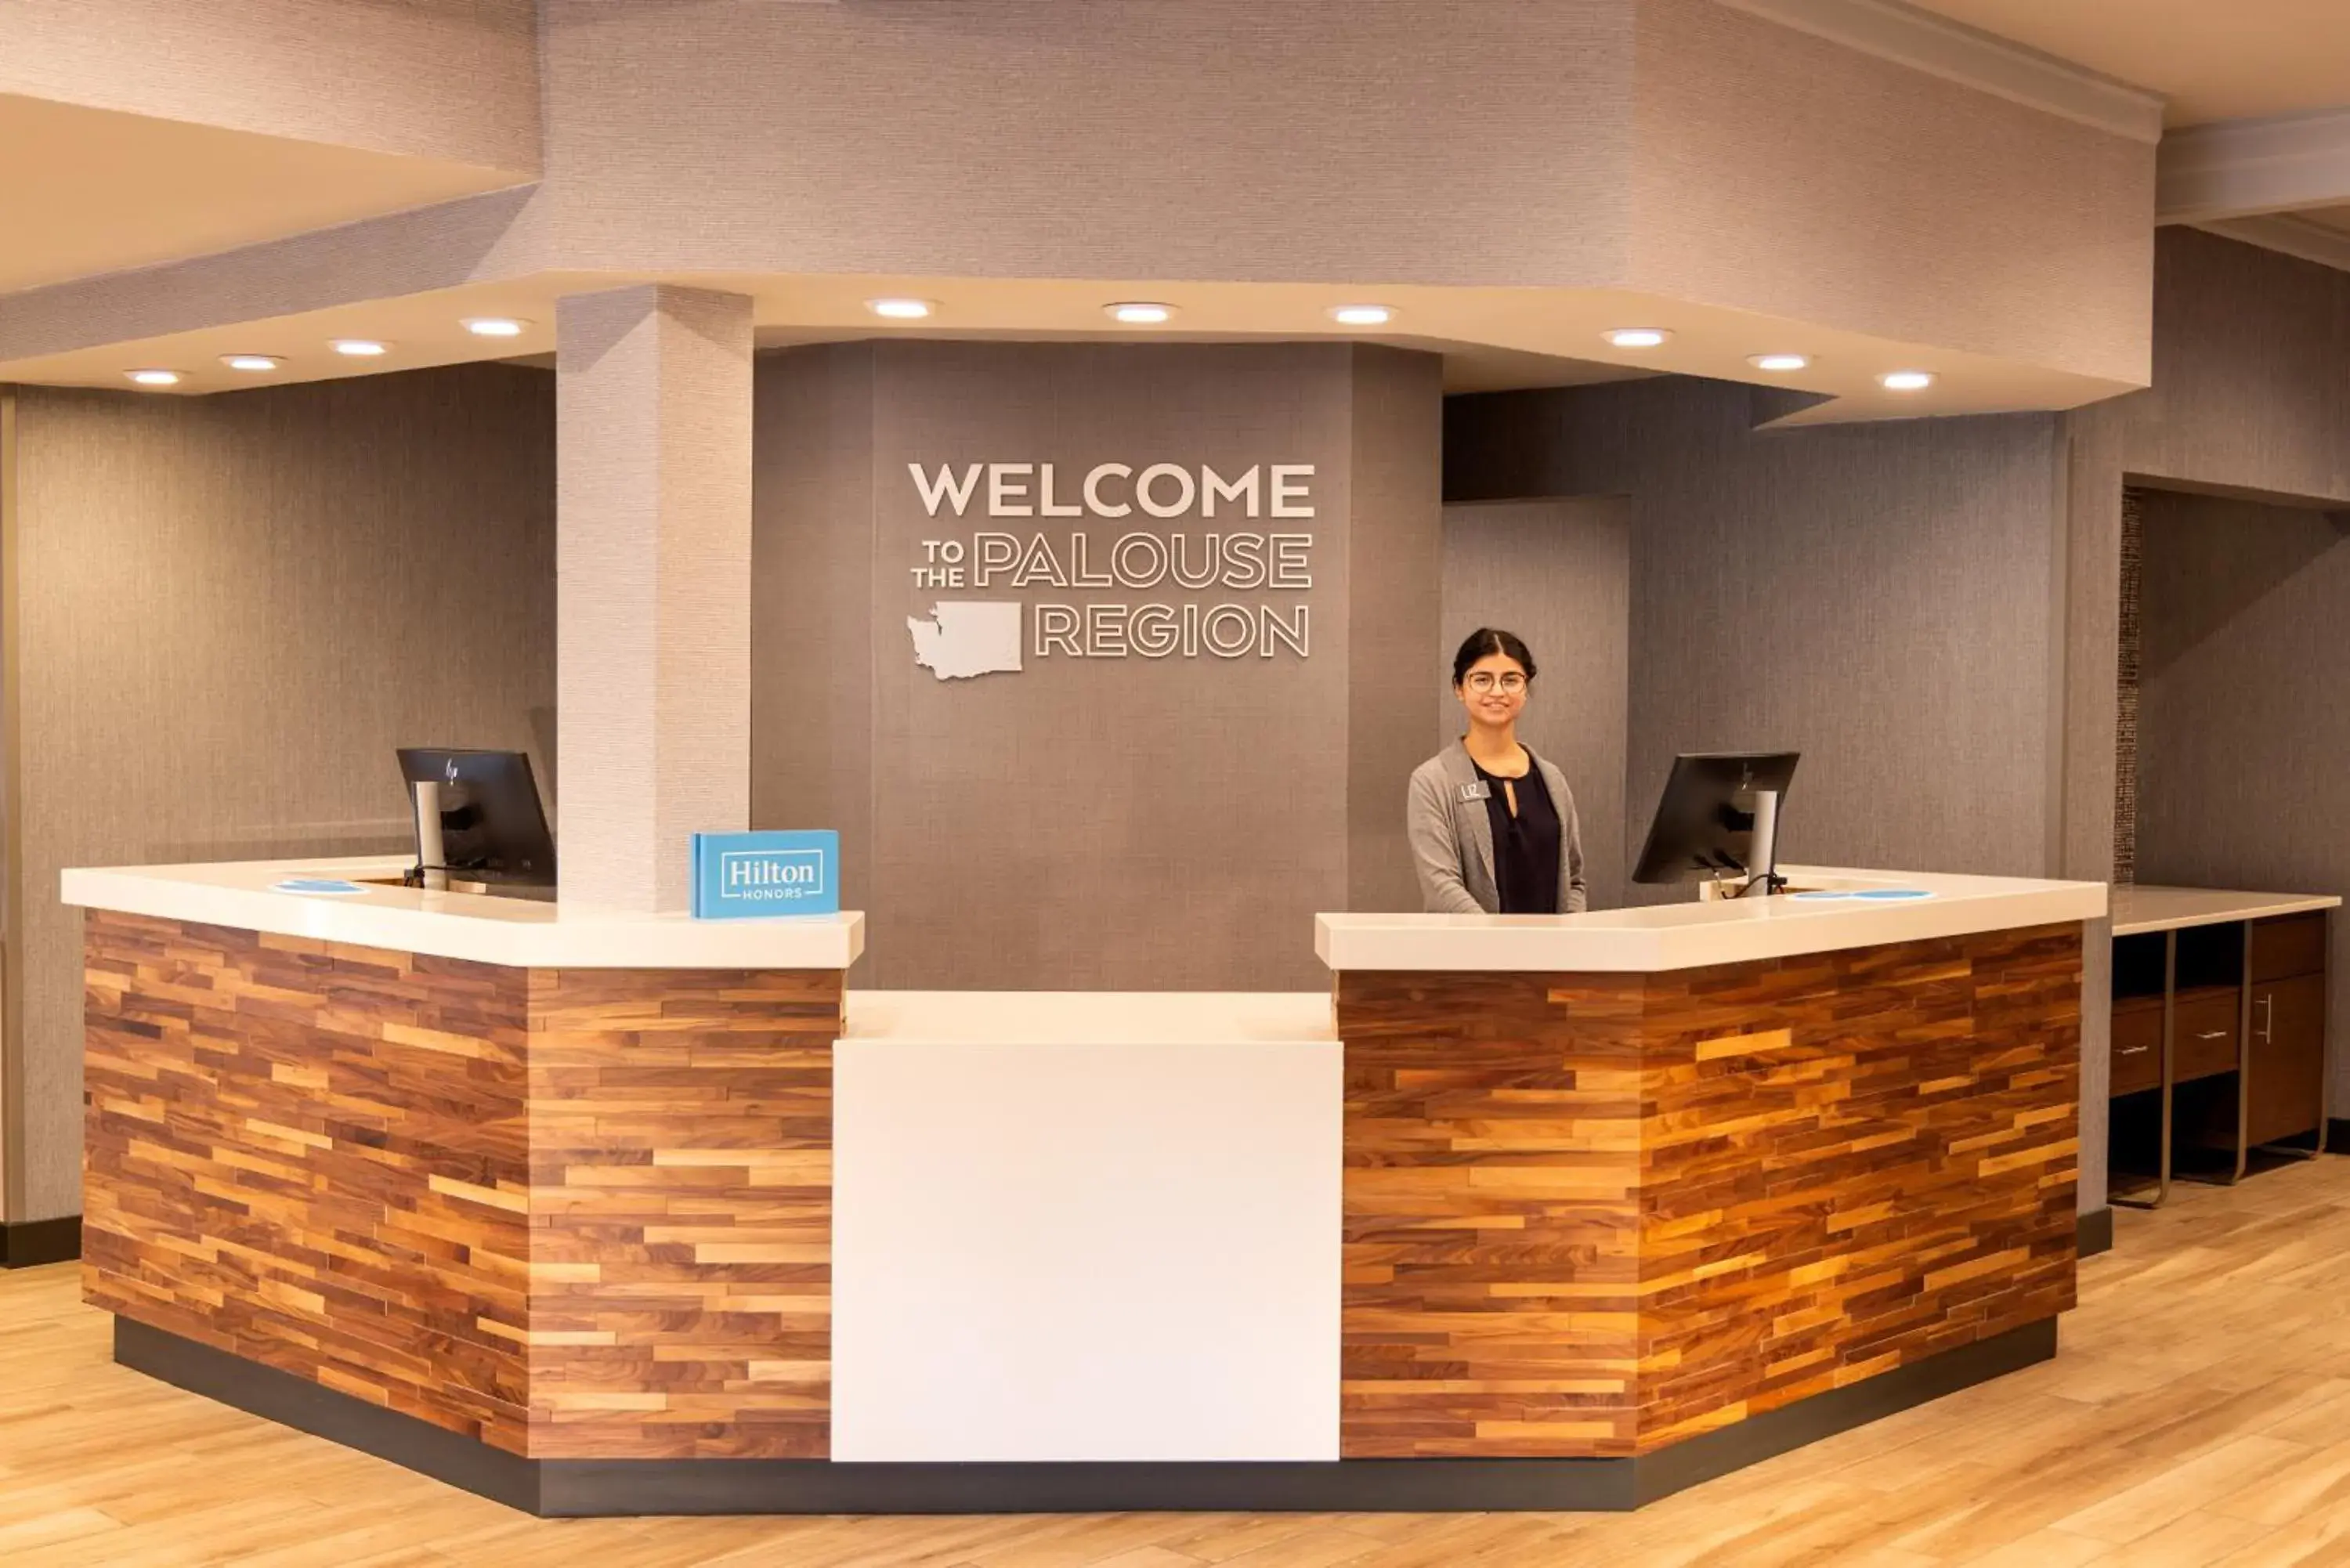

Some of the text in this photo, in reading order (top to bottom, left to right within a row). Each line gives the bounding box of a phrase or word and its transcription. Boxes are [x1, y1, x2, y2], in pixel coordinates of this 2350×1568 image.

[909, 463, 1314, 517] WELCOME
[922, 540, 964, 563] TO
[974, 533, 1312, 588] PALOUSE
[911, 567, 964, 587] THE
[1034, 604, 1309, 658] REGION
[730, 860, 814, 885] Hilton
[743, 887, 803, 899] HONORS
